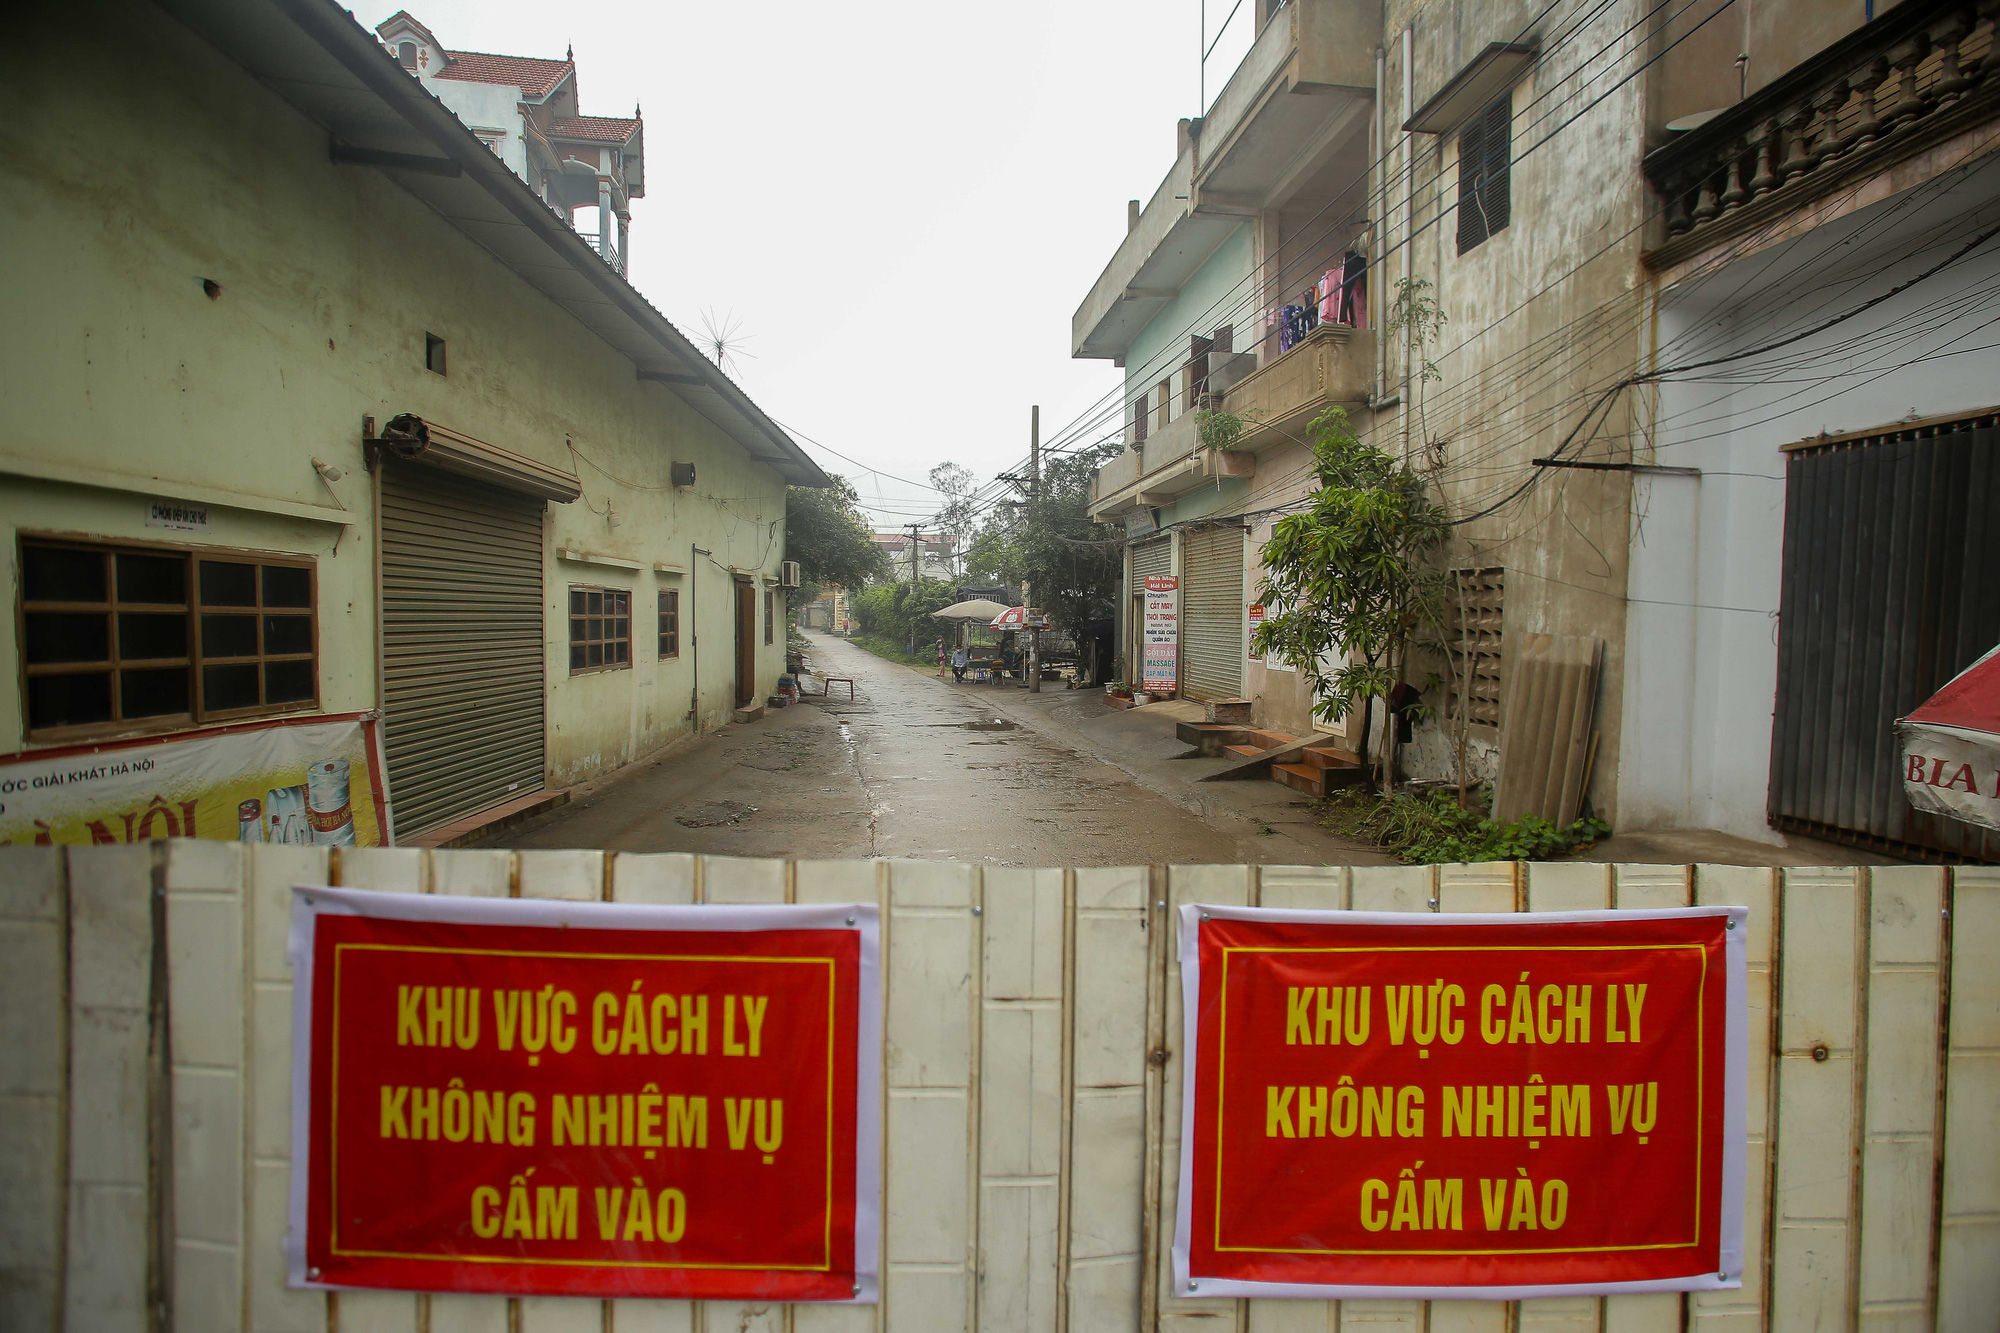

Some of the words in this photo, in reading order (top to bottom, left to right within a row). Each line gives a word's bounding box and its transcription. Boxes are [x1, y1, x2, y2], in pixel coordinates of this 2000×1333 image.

[0, 778, 28, 793] ỚC
[33, 772, 64, 788] GIẢI
[69, 766, 107, 783] KHÁT
[110, 762, 129, 776] HÀ
[133, 758, 155, 772] NỘI
[1906, 753, 1980, 795] BIA
[397, 984, 480, 1050] KHU
[494, 984, 578, 1066] VỰC
[592, 979, 708, 1056] CÁCH
[723, 994, 769, 1057] LY
[1286, 985, 1372, 1046] KHU
[1385, 978, 1466, 1059] VỰC
[1480, 971, 1593, 1045] CÁCH
[1606, 983, 1648, 1043] LY
[380, 1078, 537, 1147] KHÔNG
[552, 1083, 708, 1159] NHIỆM
[723, 1097, 784, 1165] VỤ
[1266, 1076, 1425, 1139] KHÔNG
[1441, 1073, 1592, 1150] NHIỆM
[1606, 1081, 1659, 1145] VỤ
[471, 1168, 579, 1240] CẤM
[595, 1177, 687, 1243] VÀO
[1360, 1160, 1464, 1232] CẤM
[1479, 1167, 1569, 1231] VÀO
